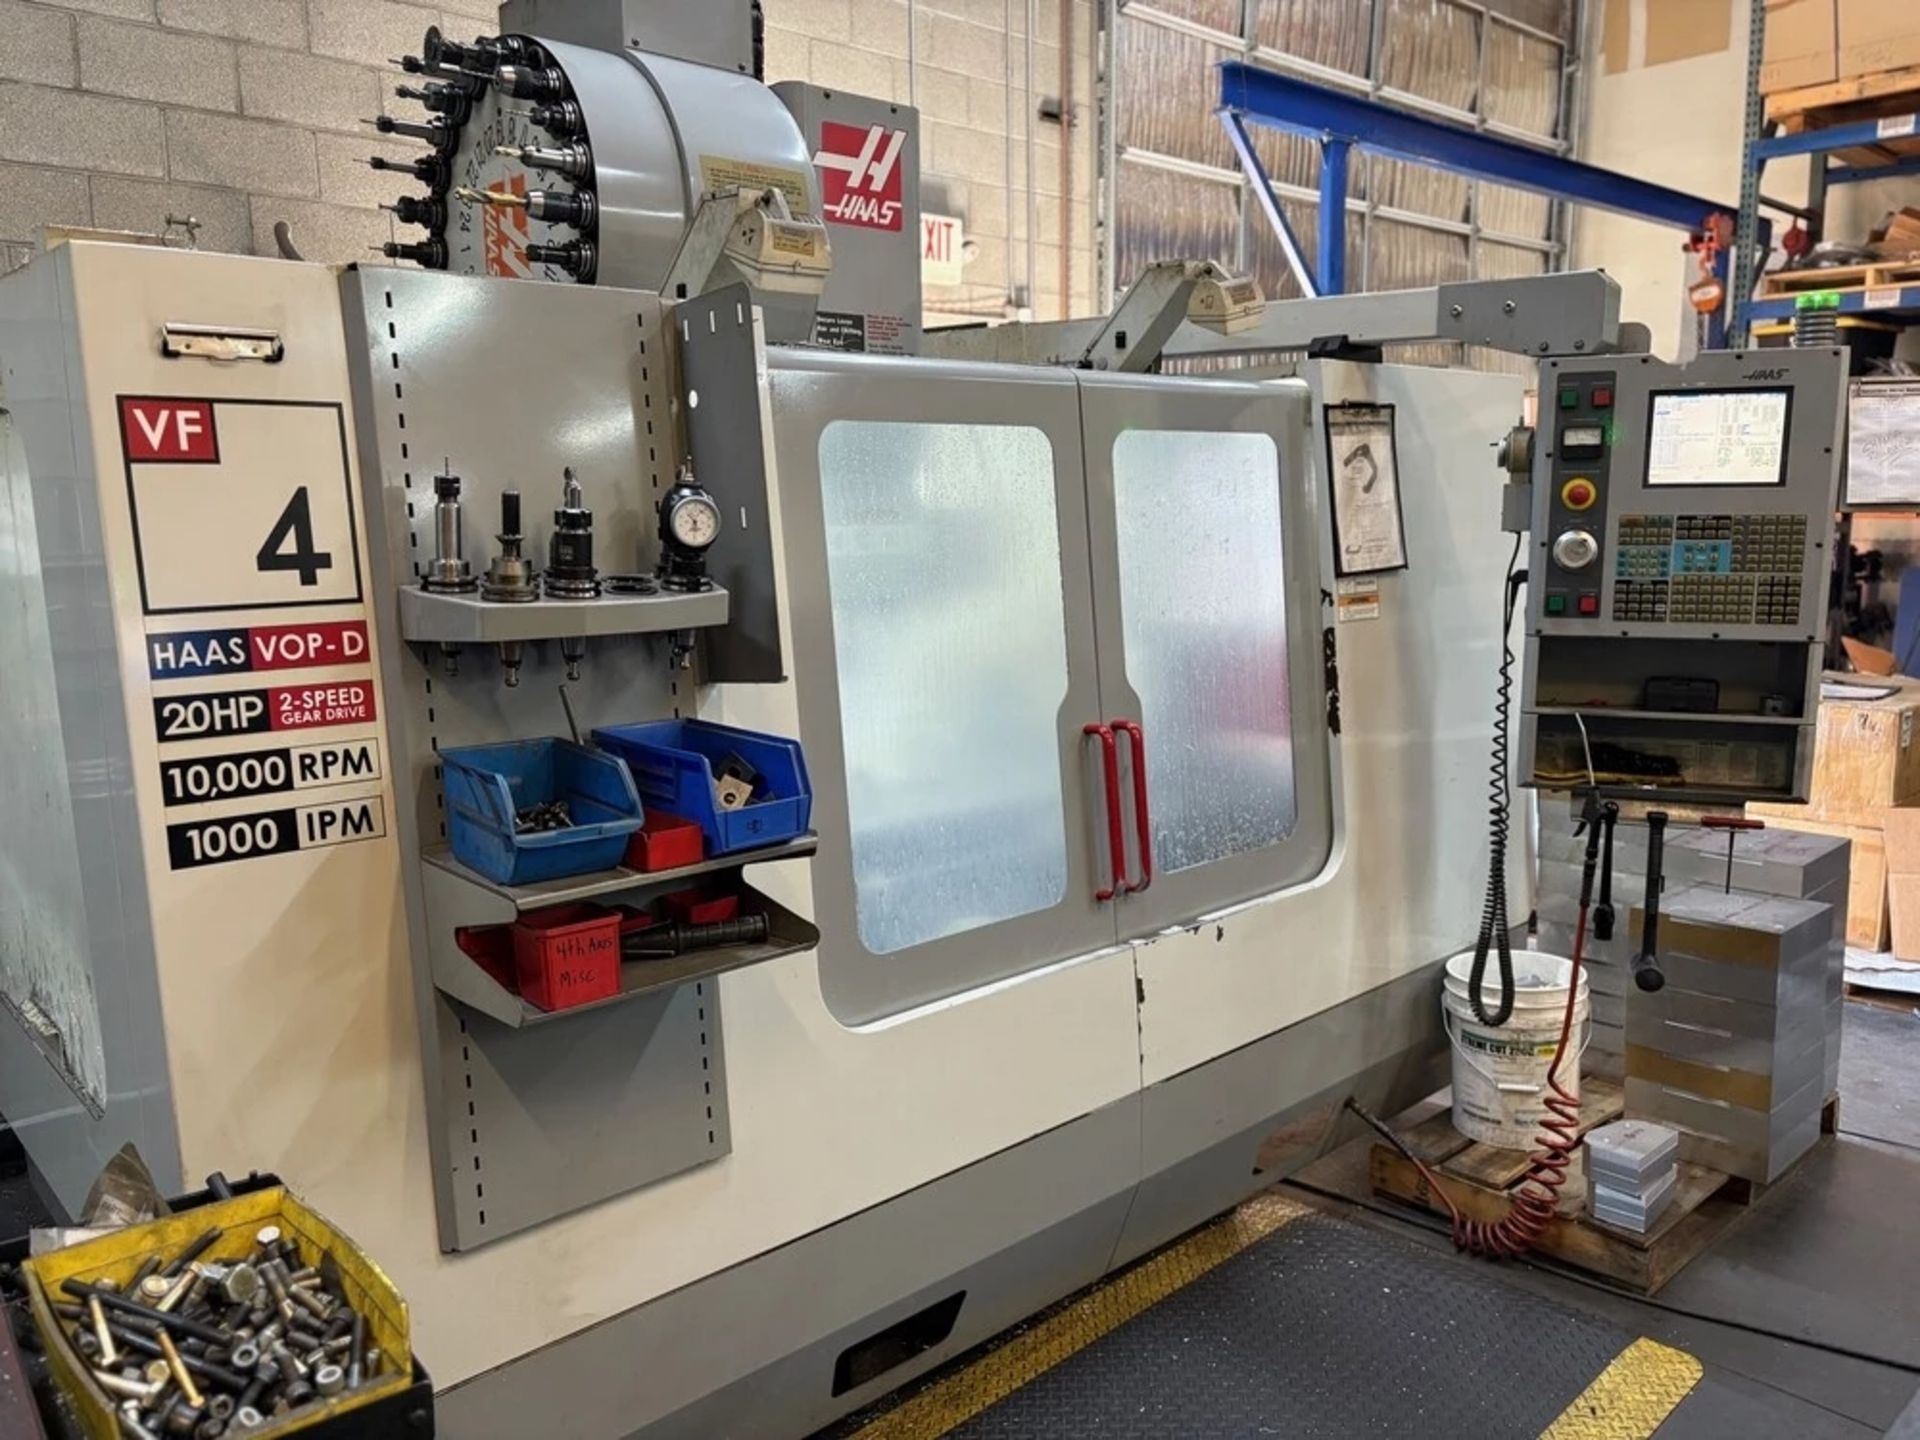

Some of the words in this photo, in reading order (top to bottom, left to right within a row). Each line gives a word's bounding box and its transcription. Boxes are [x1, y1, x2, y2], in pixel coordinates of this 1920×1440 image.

[823, 193, 903, 225] HAAS
[922, 217, 954, 263] XIT
[1742, 368, 1790, 381] HAAS
[132, 407, 203, 453] VF
[255, 485, 333, 587] 4
[152, 635, 246, 671] HAAS
[162, 694, 266, 738] 20HP
[278, 686, 366, 712] 2-SPEED
[280, 707, 322, 726] GEAR
[324, 703, 367, 722] DRIVE
[166, 754, 287, 800] 10,000
[298, 745, 373, 781] RPM
[185, 817, 279, 863] 1000
[306, 806, 374, 843] IPM
